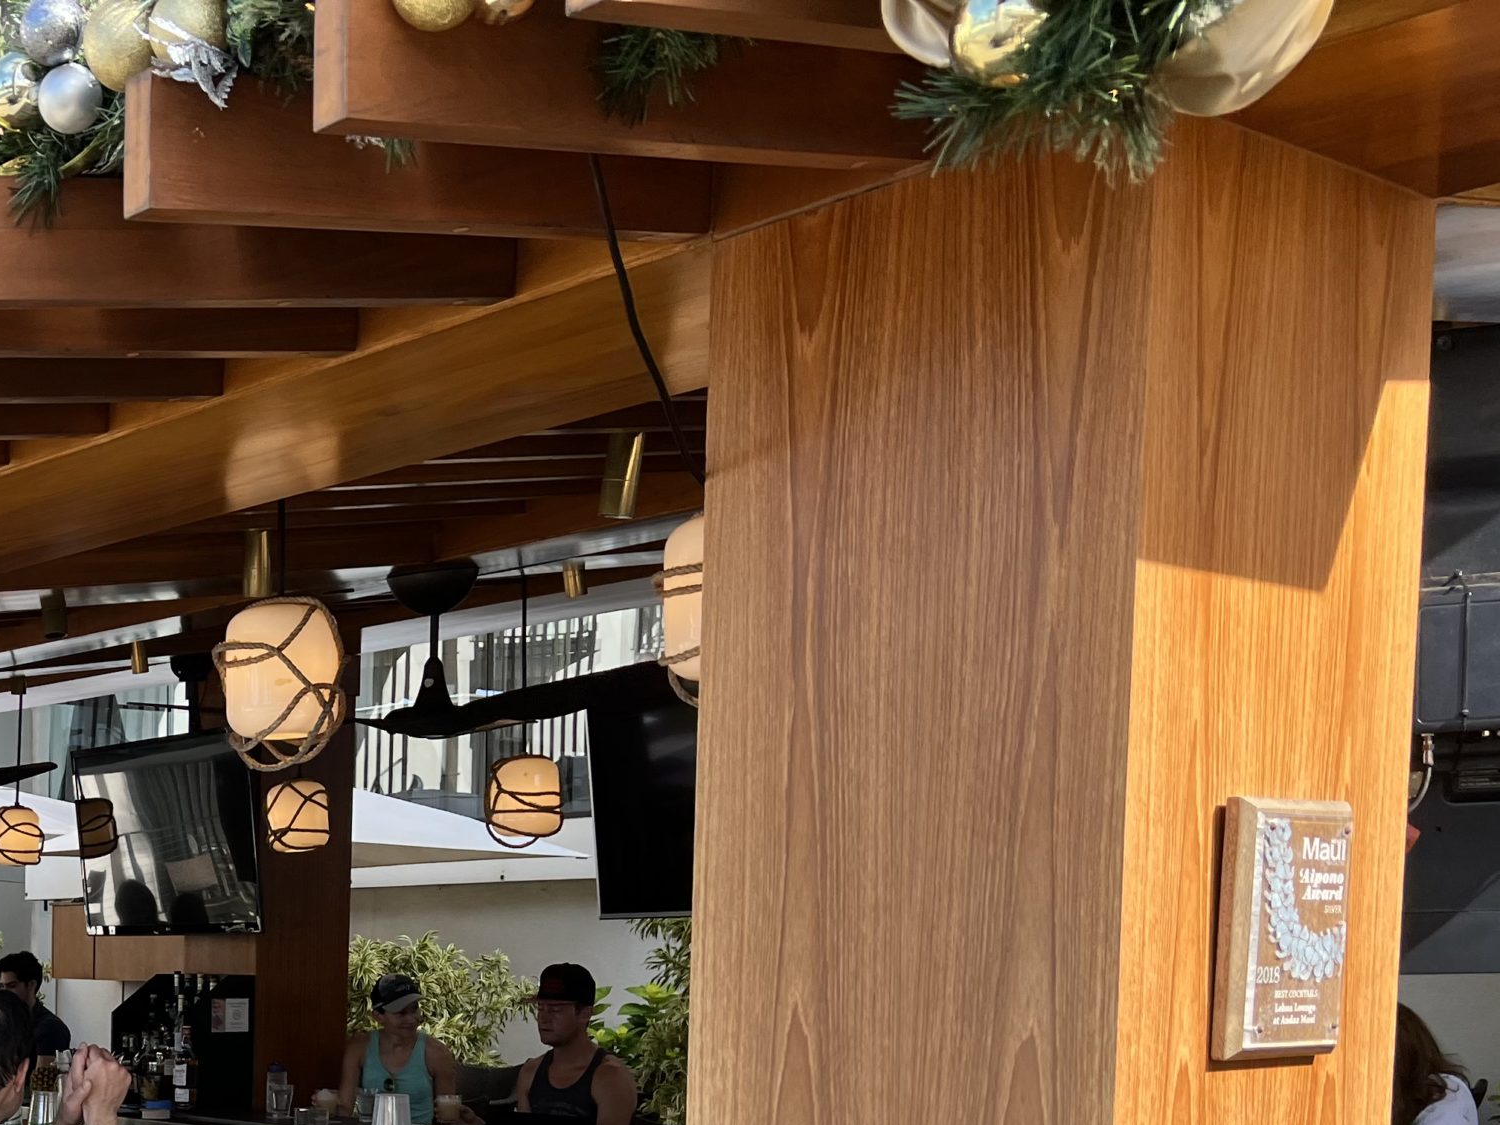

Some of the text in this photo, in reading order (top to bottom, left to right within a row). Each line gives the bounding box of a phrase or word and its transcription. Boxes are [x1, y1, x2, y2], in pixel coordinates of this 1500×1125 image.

[1303, 836, 1346, 861] Maui
[1302, 885, 1343, 901] Award
[1256, 965, 1280, 984] 2018
[1274, 990, 1288, 998] BEST
